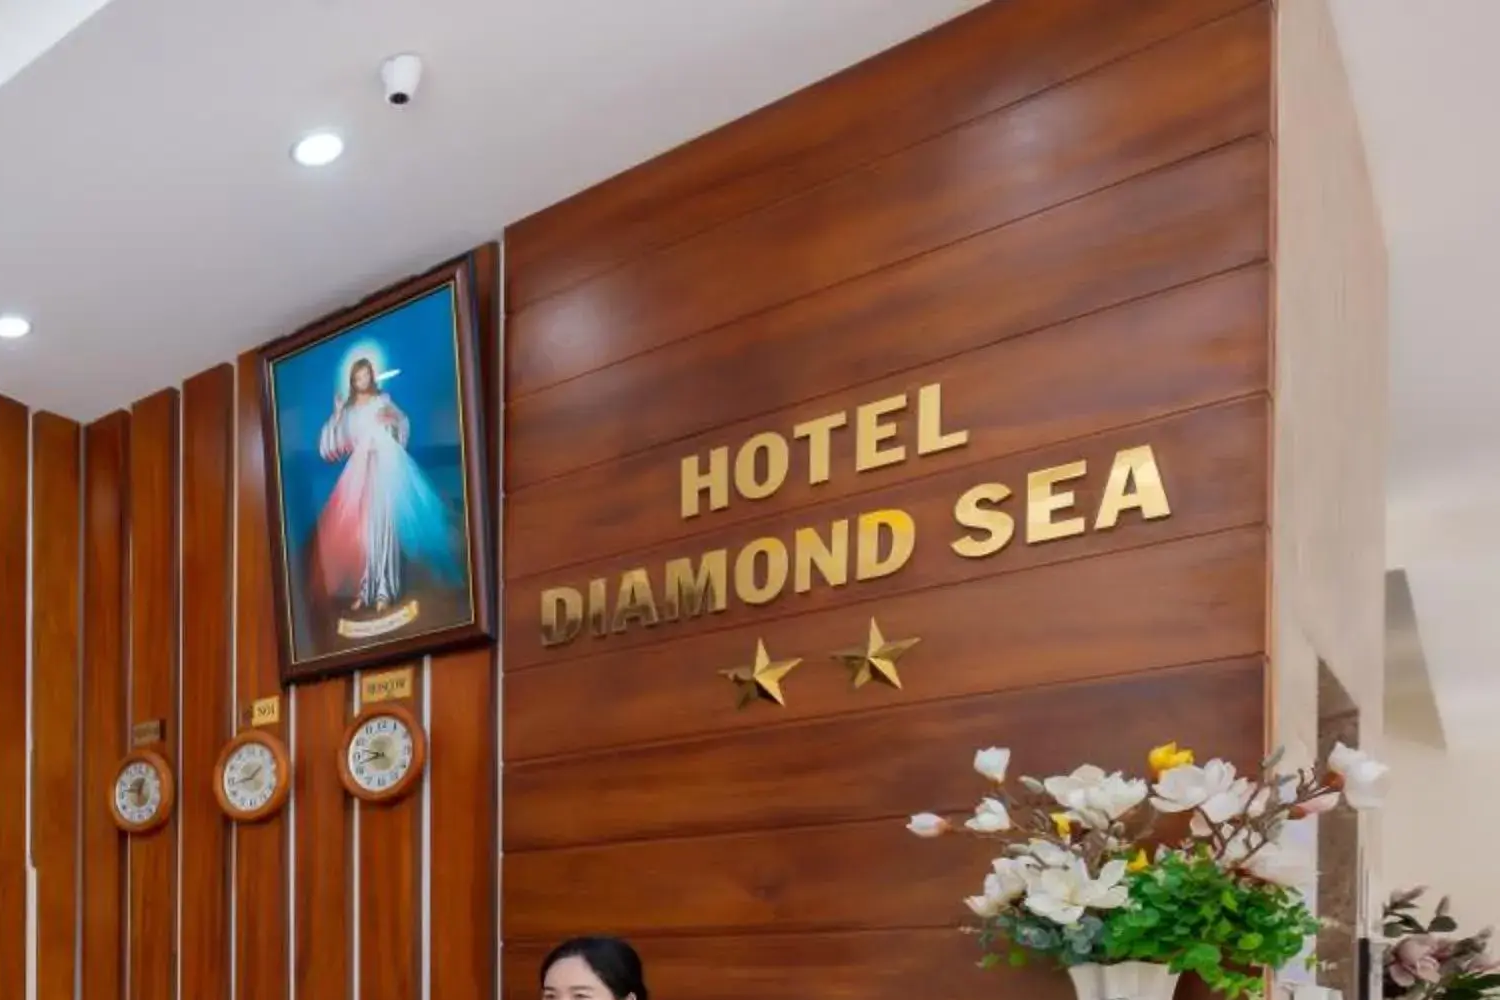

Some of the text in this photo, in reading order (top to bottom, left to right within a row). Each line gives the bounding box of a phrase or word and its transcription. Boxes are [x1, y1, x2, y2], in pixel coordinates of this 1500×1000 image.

[680, 383, 969, 519] HOTEL
[540, 444, 1171, 647] DIAMOND SEA
